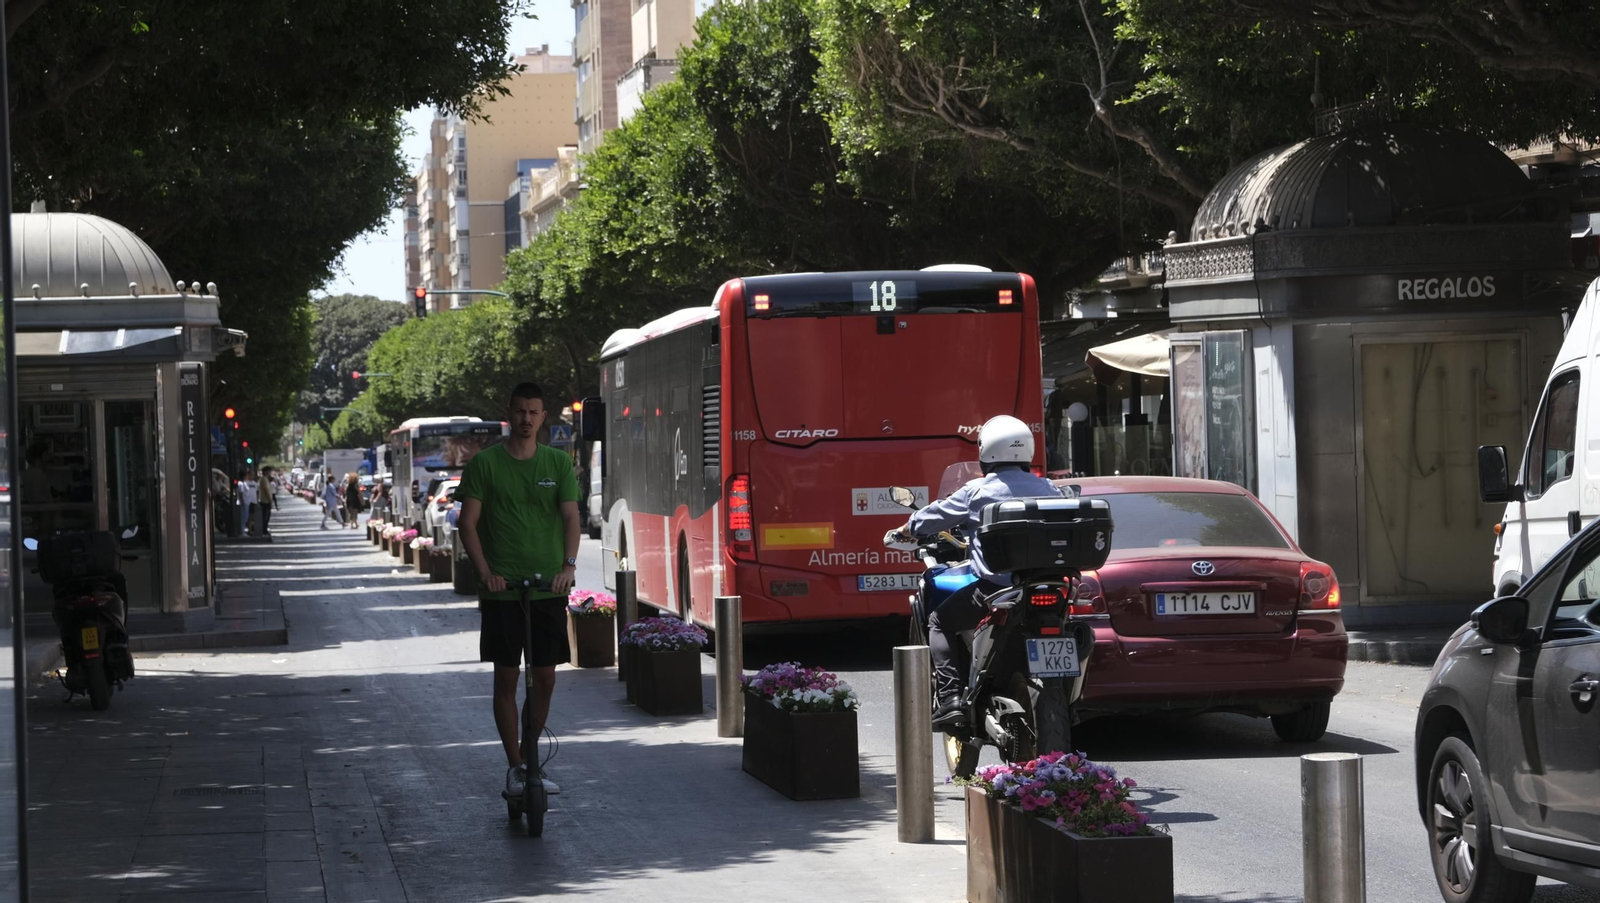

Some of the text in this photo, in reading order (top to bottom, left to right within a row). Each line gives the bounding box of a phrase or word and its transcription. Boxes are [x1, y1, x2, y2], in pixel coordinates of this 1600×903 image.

[869, 280, 897, 312] 18
[1397, 275, 1496, 301] REGALOS
[775, 428, 839, 438] CITARO
[808, 548, 879, 566] Almería
[865, 576, 896, 588] 5283
[1170, 595, 1210, 612] 1114
[1220, 594, 1251, 611] CJV
[1041, 640, 1074, 655] 1279
[1044, 656, 1072, 670] KKG
